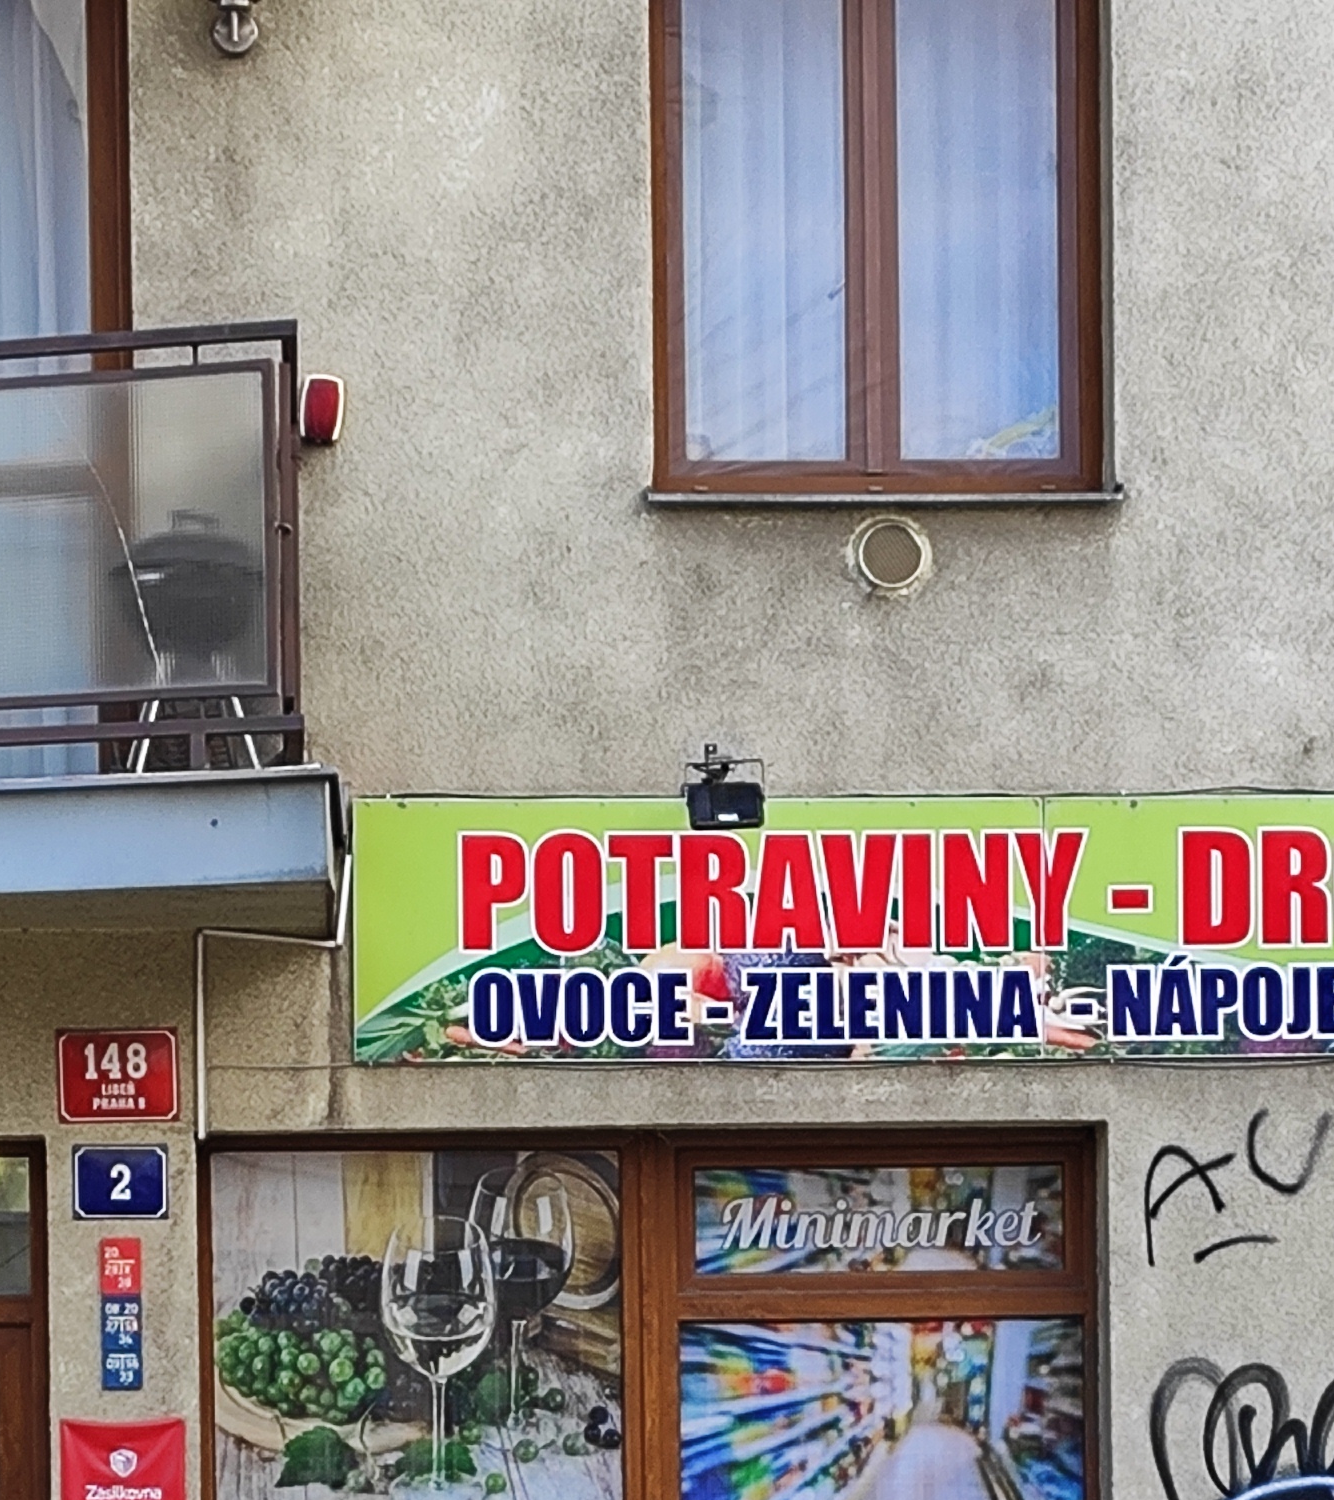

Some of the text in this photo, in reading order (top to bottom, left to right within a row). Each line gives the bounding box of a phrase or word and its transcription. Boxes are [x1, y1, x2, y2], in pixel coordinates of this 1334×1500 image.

[458, 830, 1088, 953] POTRAVINY
[468, 967, 695, 1047] OVOCE
[741, 968, 1041, 1045] ZELENINA
[84, 1042, 148, 1080] 148
[92, 1097, 135, 1111] PRAHA
[110, 1163, 131, 1200] 2
[721, 1195, 1043, 1251] Minimarket
